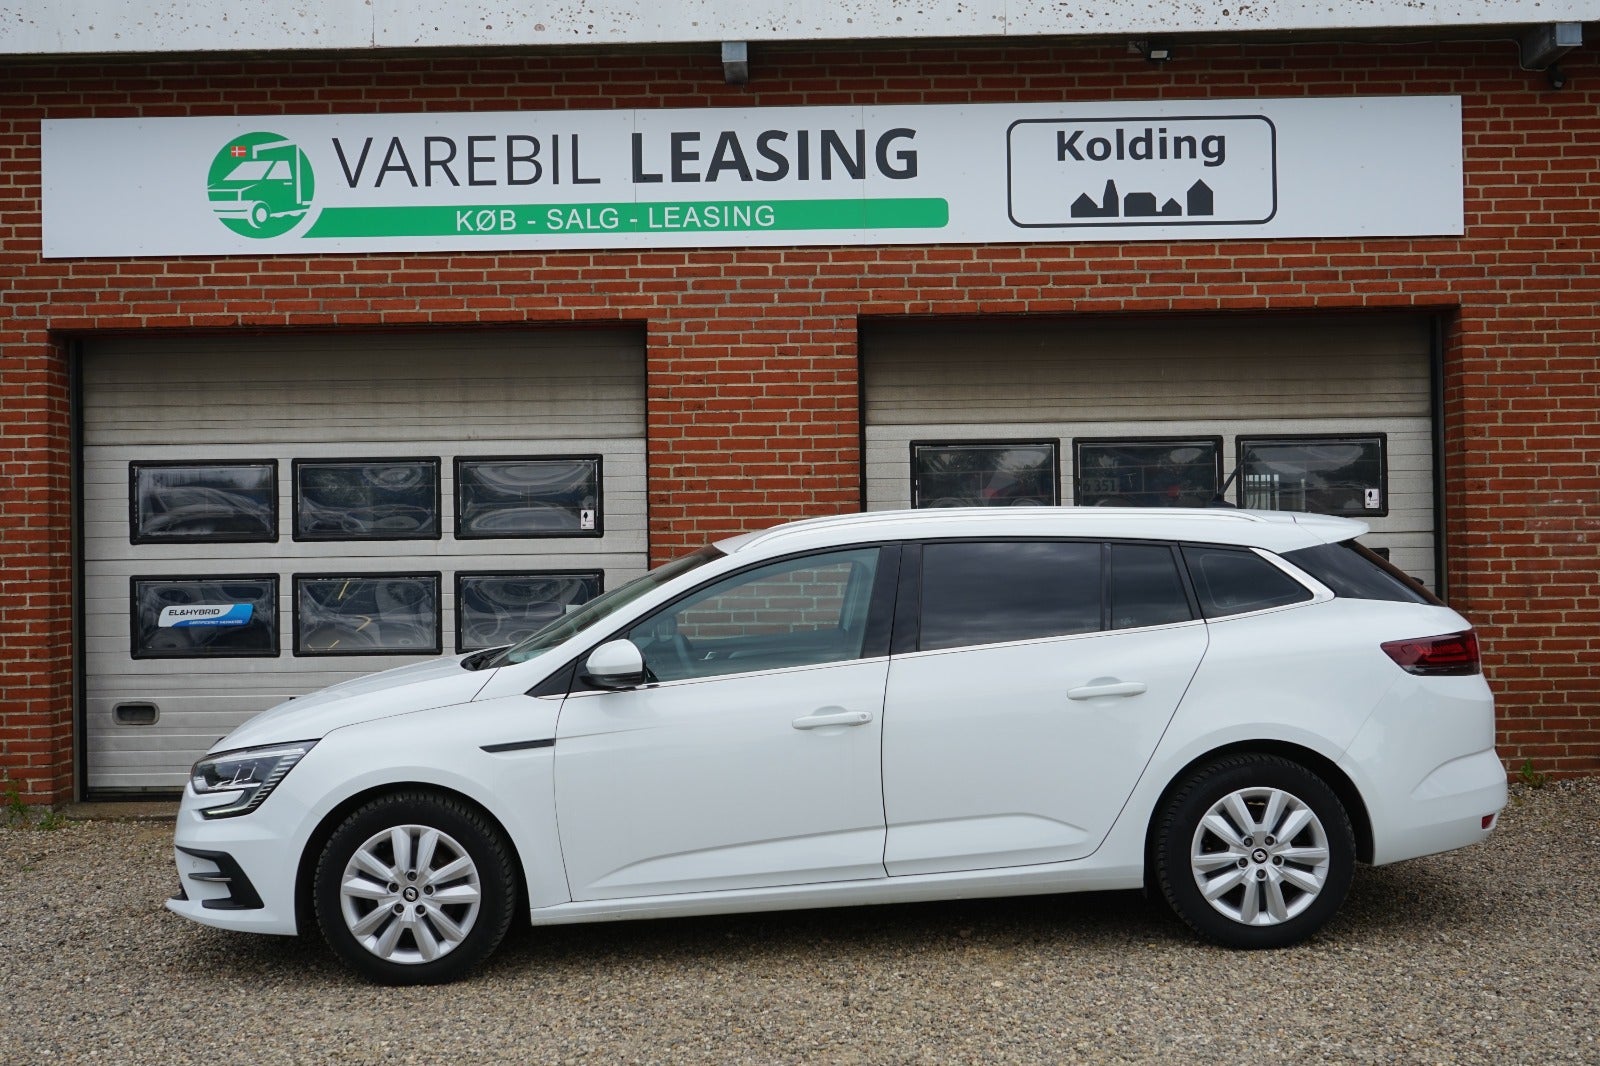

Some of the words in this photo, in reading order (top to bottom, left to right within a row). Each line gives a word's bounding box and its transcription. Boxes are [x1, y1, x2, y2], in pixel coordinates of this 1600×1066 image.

[331, 133, 601, 189] VAREBIL
[631, 127, 919, 184] LEASING
[1056, 127, 1226, 168] Kolding
[456, 208, 517, 232] KØB
[546, 207, 620, 230] SALG
[648, 204, 776, 228] LEASING
[168, 608, 220, 617] EL&HYBRID
